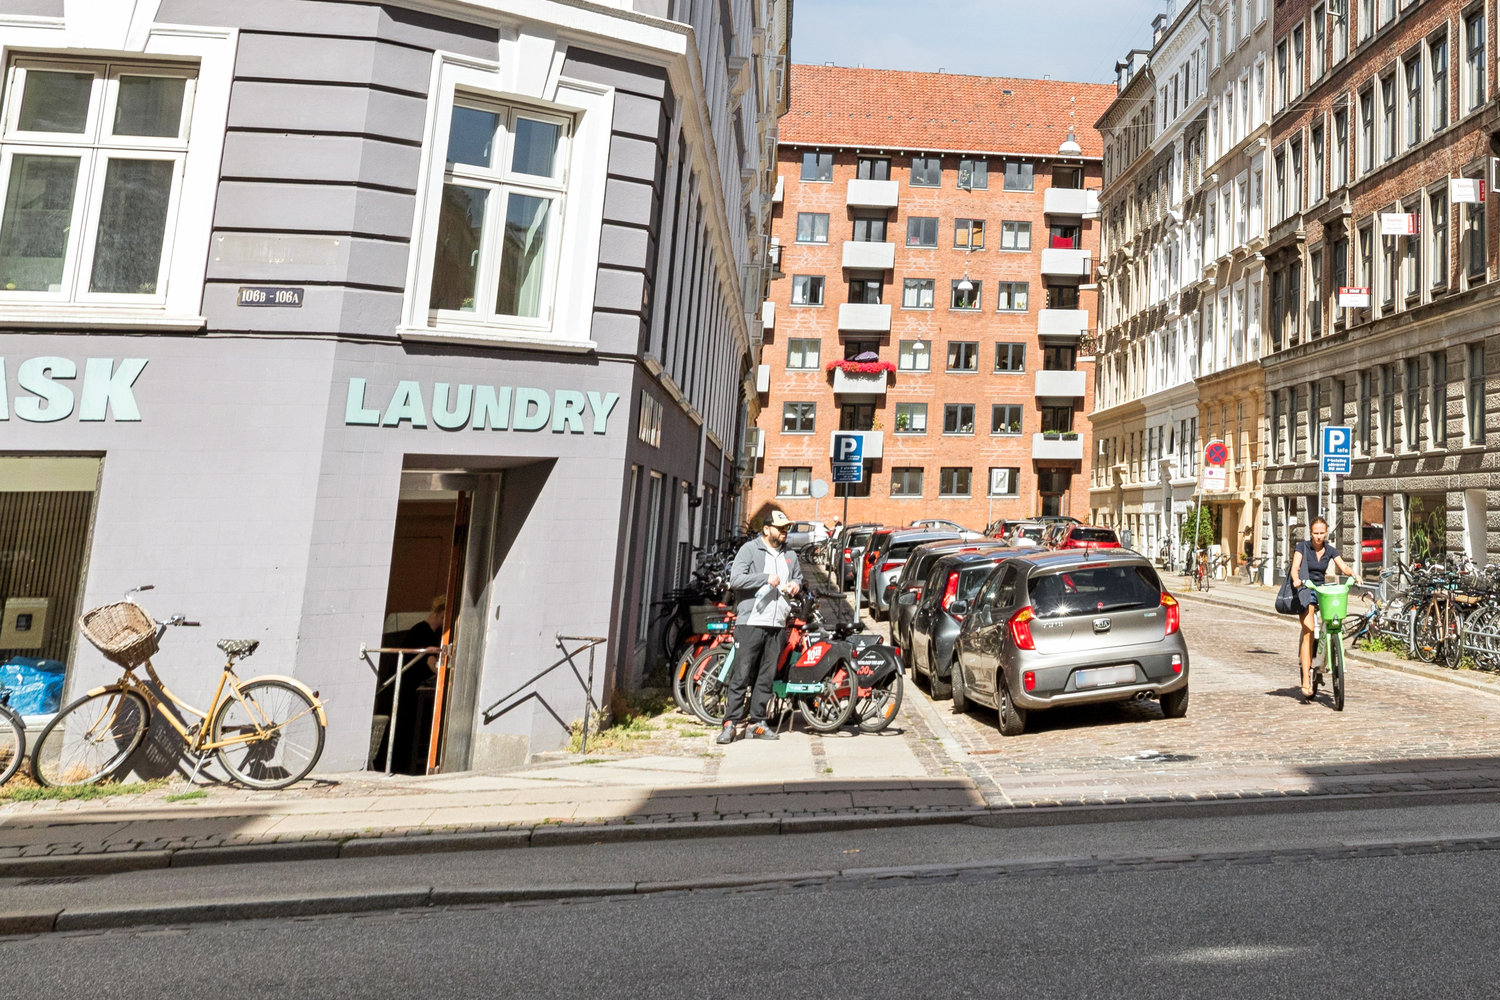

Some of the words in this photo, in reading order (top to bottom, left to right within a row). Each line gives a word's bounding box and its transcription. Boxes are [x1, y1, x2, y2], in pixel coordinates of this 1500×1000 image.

[241, 290, 266, 302] 106B
[275, 290, 299, 303] 106A
[0, 356, 149, 423] SK
[345, 377, 620, 435] LAUNDRY
[840, 437, 857, 460] P
[1329, 430, 1345, 453] P
